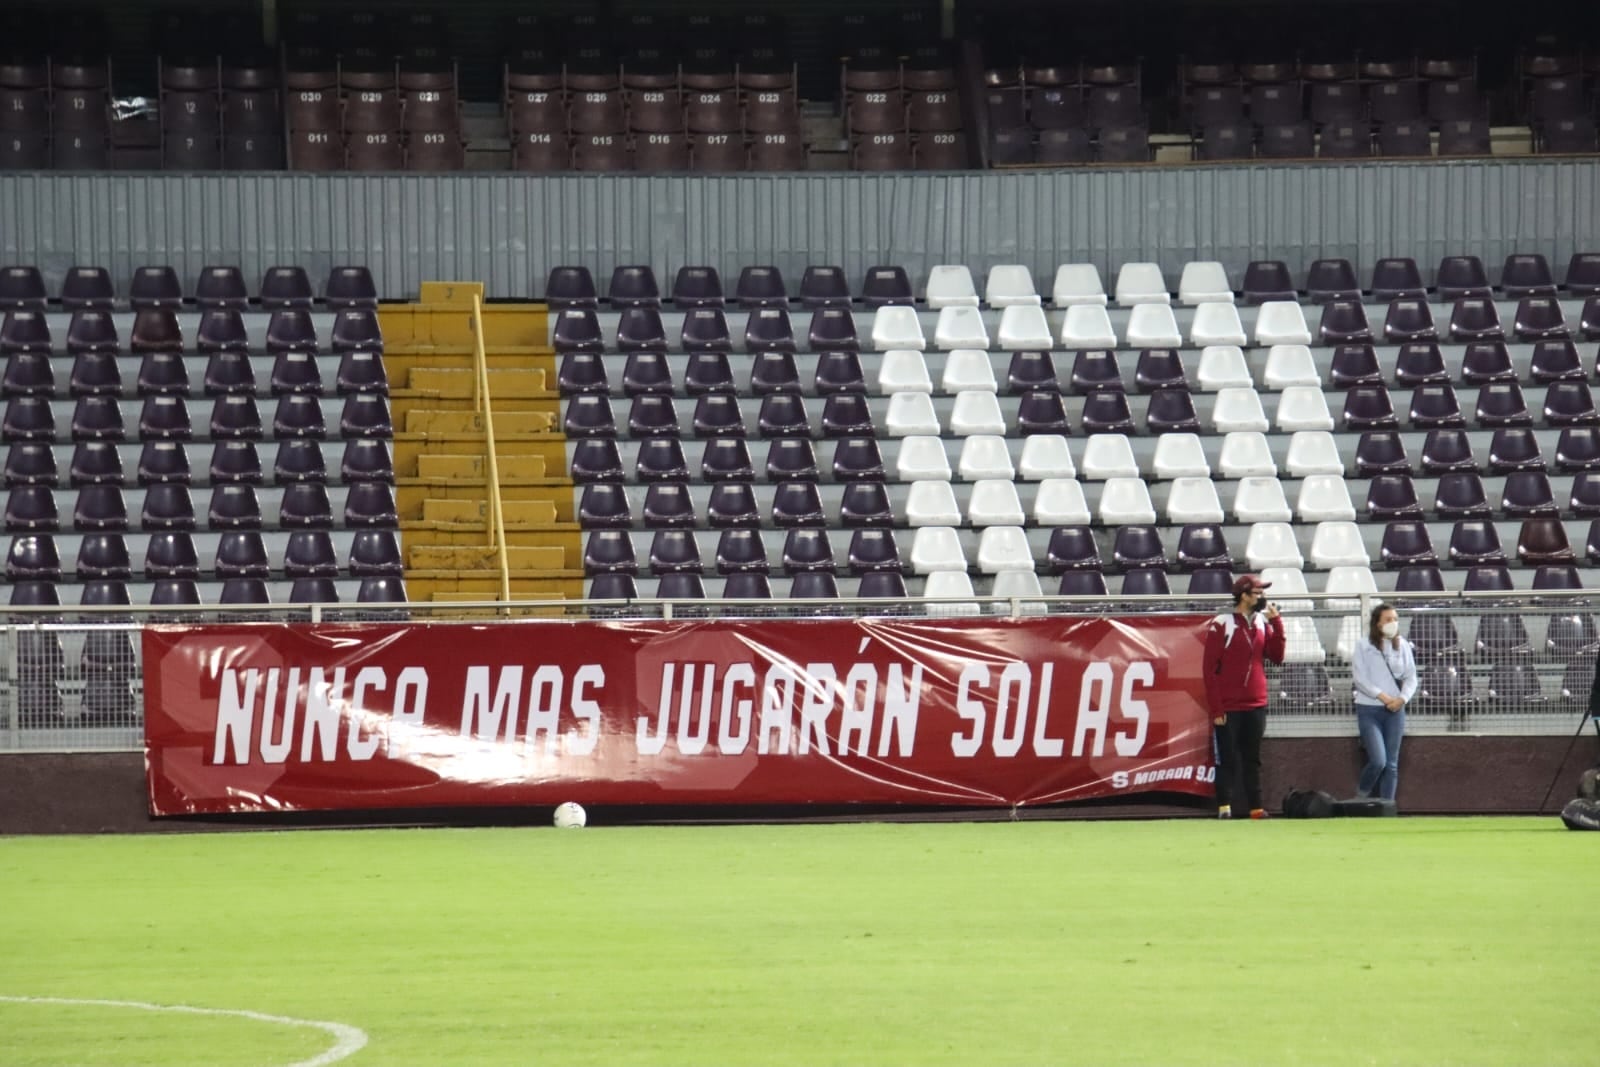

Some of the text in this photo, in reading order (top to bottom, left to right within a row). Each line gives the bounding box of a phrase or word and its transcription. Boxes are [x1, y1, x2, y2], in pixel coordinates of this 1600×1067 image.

[300, 92, 322, 103] 030
[361, 92, 382, 103] 029
[419, 91, 440, 103] 028
[527, 93, 548, 104] 027
[586, 93, 607, 103] 026
[643, 92, 665, 103] 025
[699, 94, 721, 104] 024
[758, 93, 780, 103] 023
[865, 93, 887, 104] 022
[926, 94, 946, 104] 021
[73, 97, 85, 110] 13
[185, 101, 196, 114] 12
[243, 98, 253, 111] 11
[307, 133, 328, 143] 011
[366, 134, 387, 145] 012
[423, 134, 445, 144] 013
[530, 133, 551, 144] 014
[591, 135, 613, 145] 015
[649, 134, 670, 144] 016
[707, 135, 728, 145] 017
[764, 134, 786, 144] 018
[873, 134, 896, 145] 019
[933, 133, 956, 145] 020
[213, 637, 1155, 765] NUNCA MAS JUGARÁN SOLAS
[1133, 765, 1193, 786] MORADA
[1195, 765, 1216, 783] 9.0
